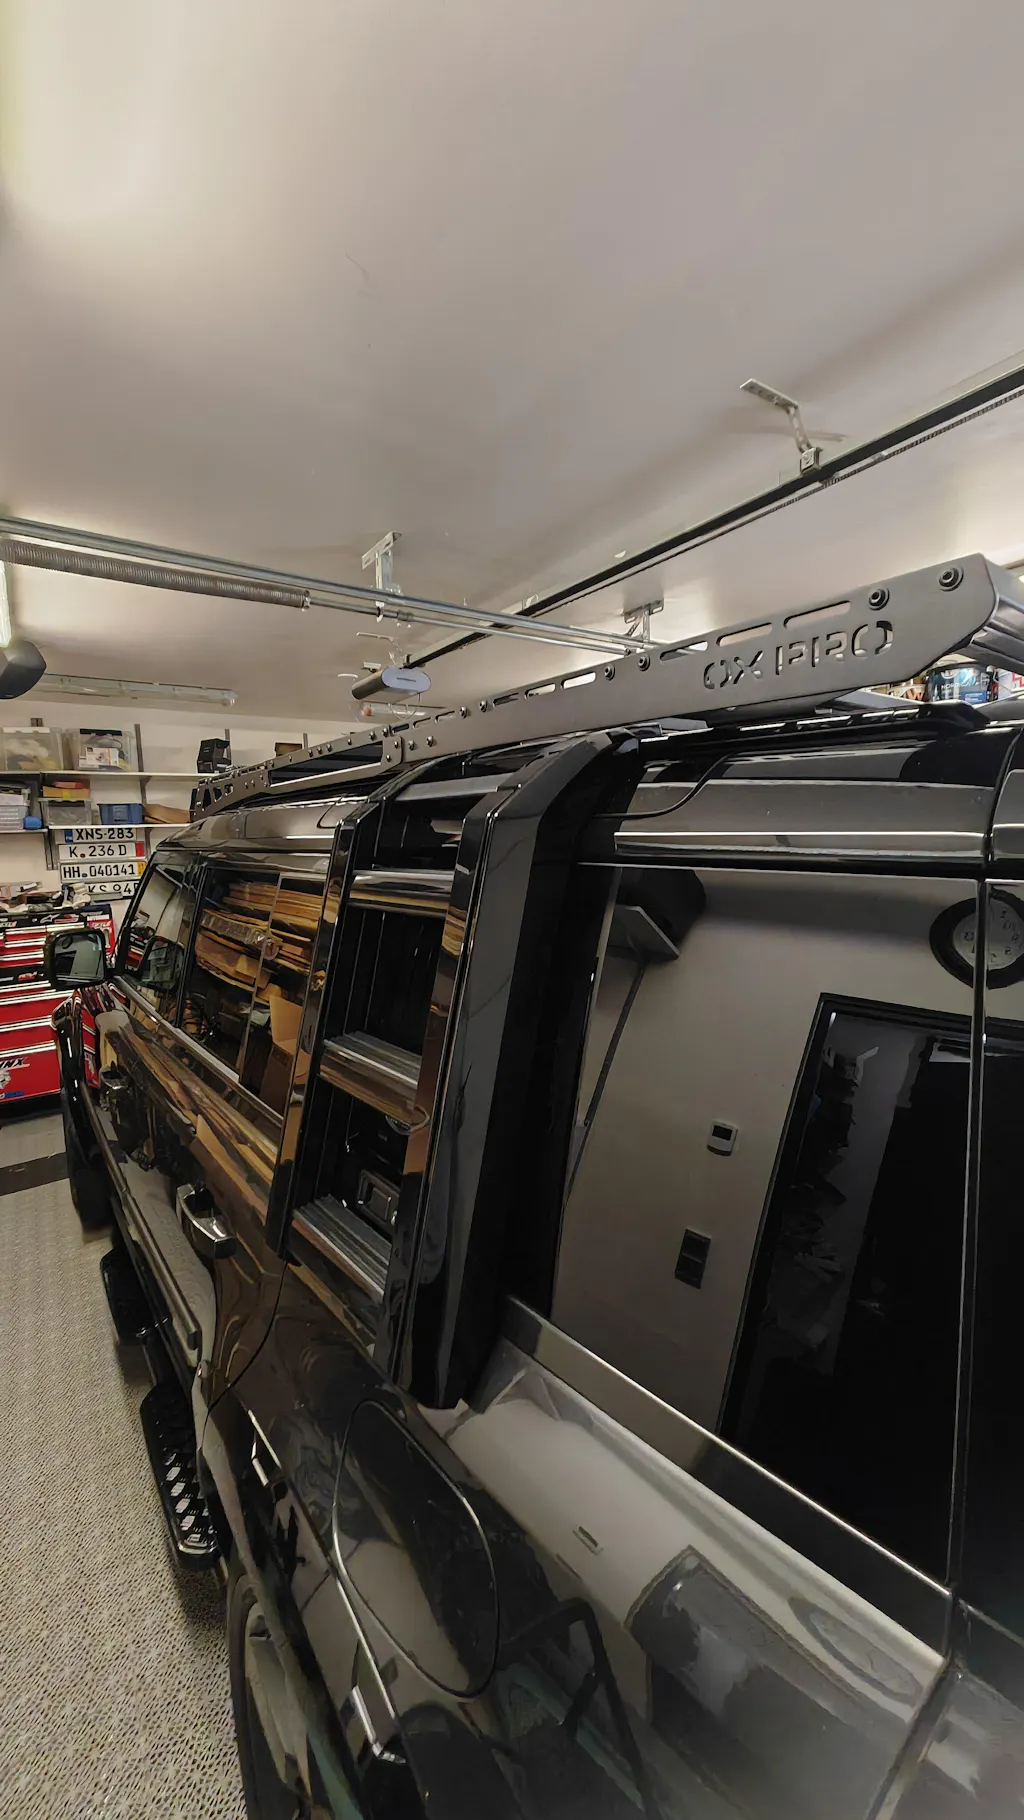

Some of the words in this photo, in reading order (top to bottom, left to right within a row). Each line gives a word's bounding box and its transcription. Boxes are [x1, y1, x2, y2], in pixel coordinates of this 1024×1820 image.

[703, 650, 763, 690] OX
[775, 620, 894, 676] PRO
[76, 828, 134, 841] XNS-283
[88, 845, 115, 857] 236
[118, 844, 127, 856] D
[63, 866, 80, 879] HH
[89, 864, 136, 878] 040141
